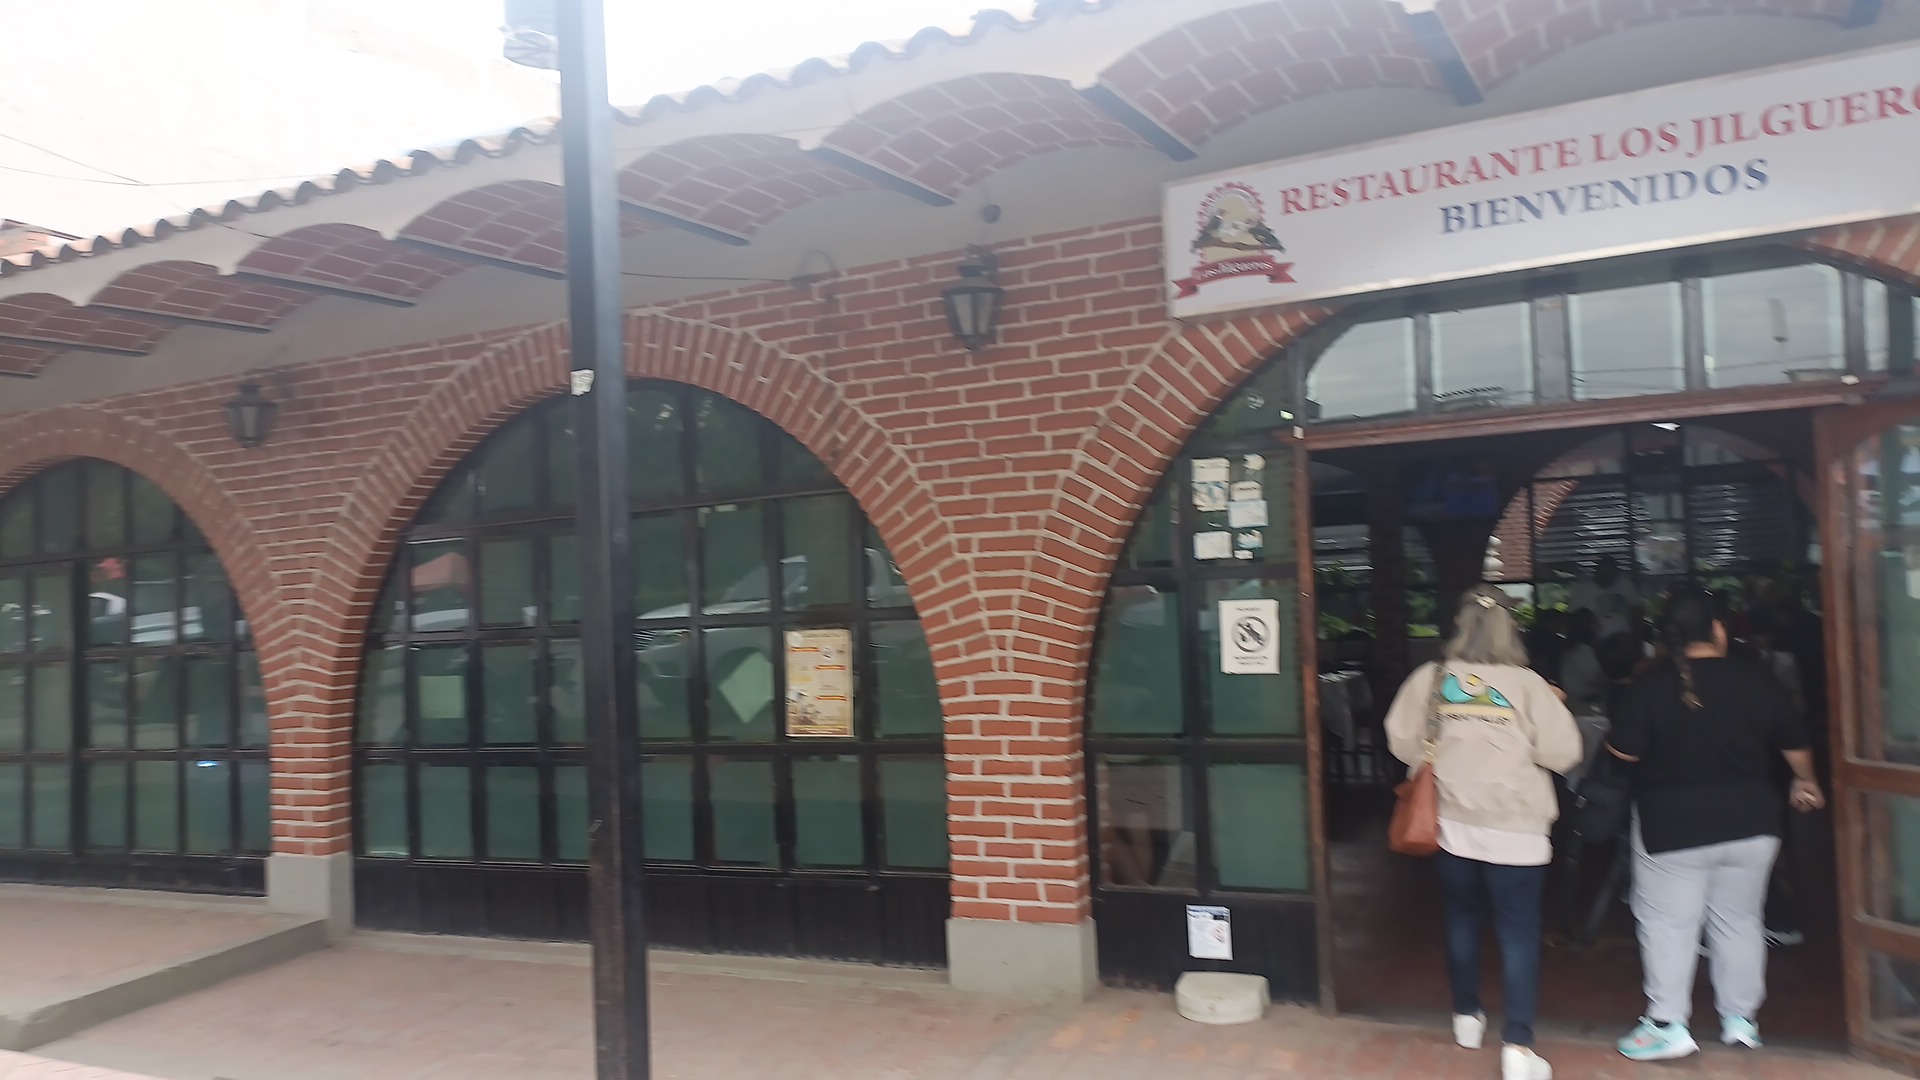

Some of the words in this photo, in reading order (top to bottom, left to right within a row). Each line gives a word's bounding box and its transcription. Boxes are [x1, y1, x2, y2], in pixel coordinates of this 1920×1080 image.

[1279, 137, 1583, 216] RESTAURANTE
[1590, 121, 1680, 163] LOS
[1685, 84, 1920, 159] JILGUER
[1439, 157, 1770, 235] BIENVENIDOS
